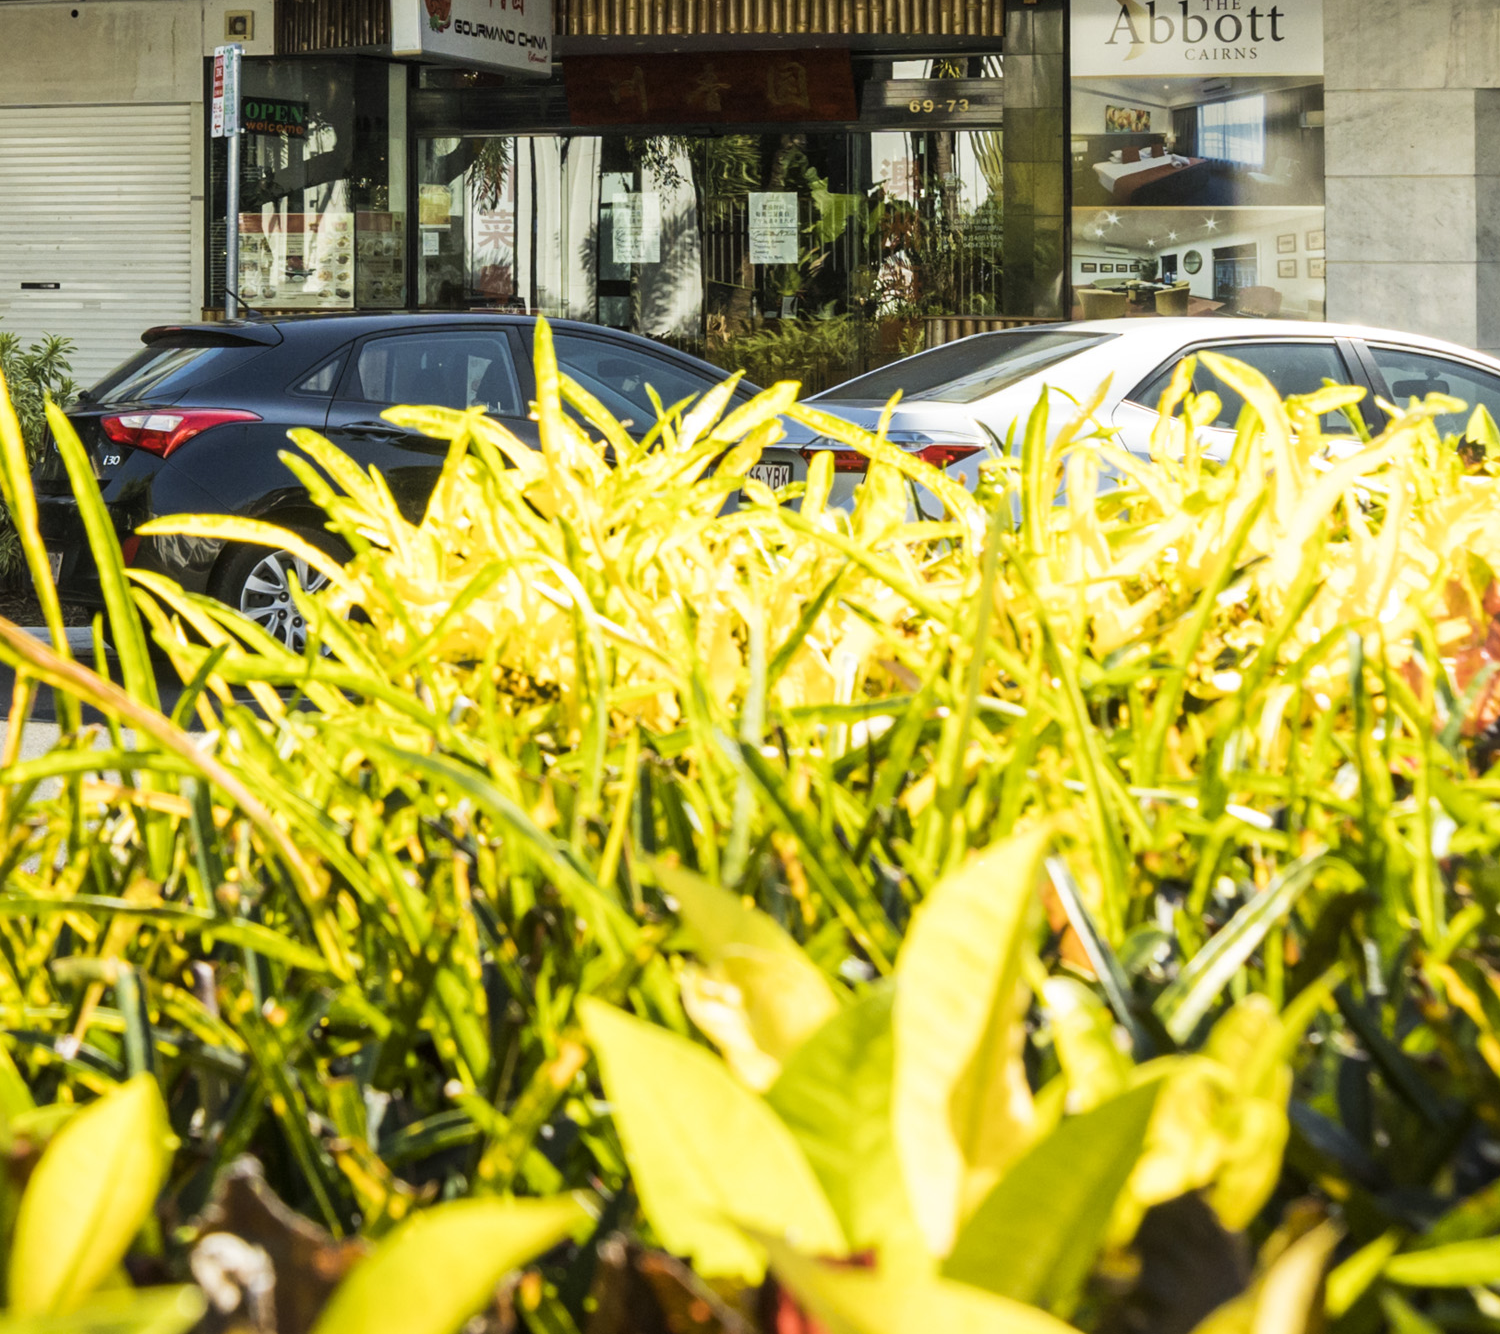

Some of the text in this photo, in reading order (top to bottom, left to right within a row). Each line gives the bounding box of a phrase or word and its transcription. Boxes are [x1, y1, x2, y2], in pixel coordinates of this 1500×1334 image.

[1104, 0, 1286, 45] Abbott
[454, 18, 548, 51] GOURMAND CHINA
[1184, 47, 1259, 61] CAIRNS
[245, 101, 304, 124] OPEN
[246, 120, 304, 135] welcome
[103, 455, 120, 466] i30
